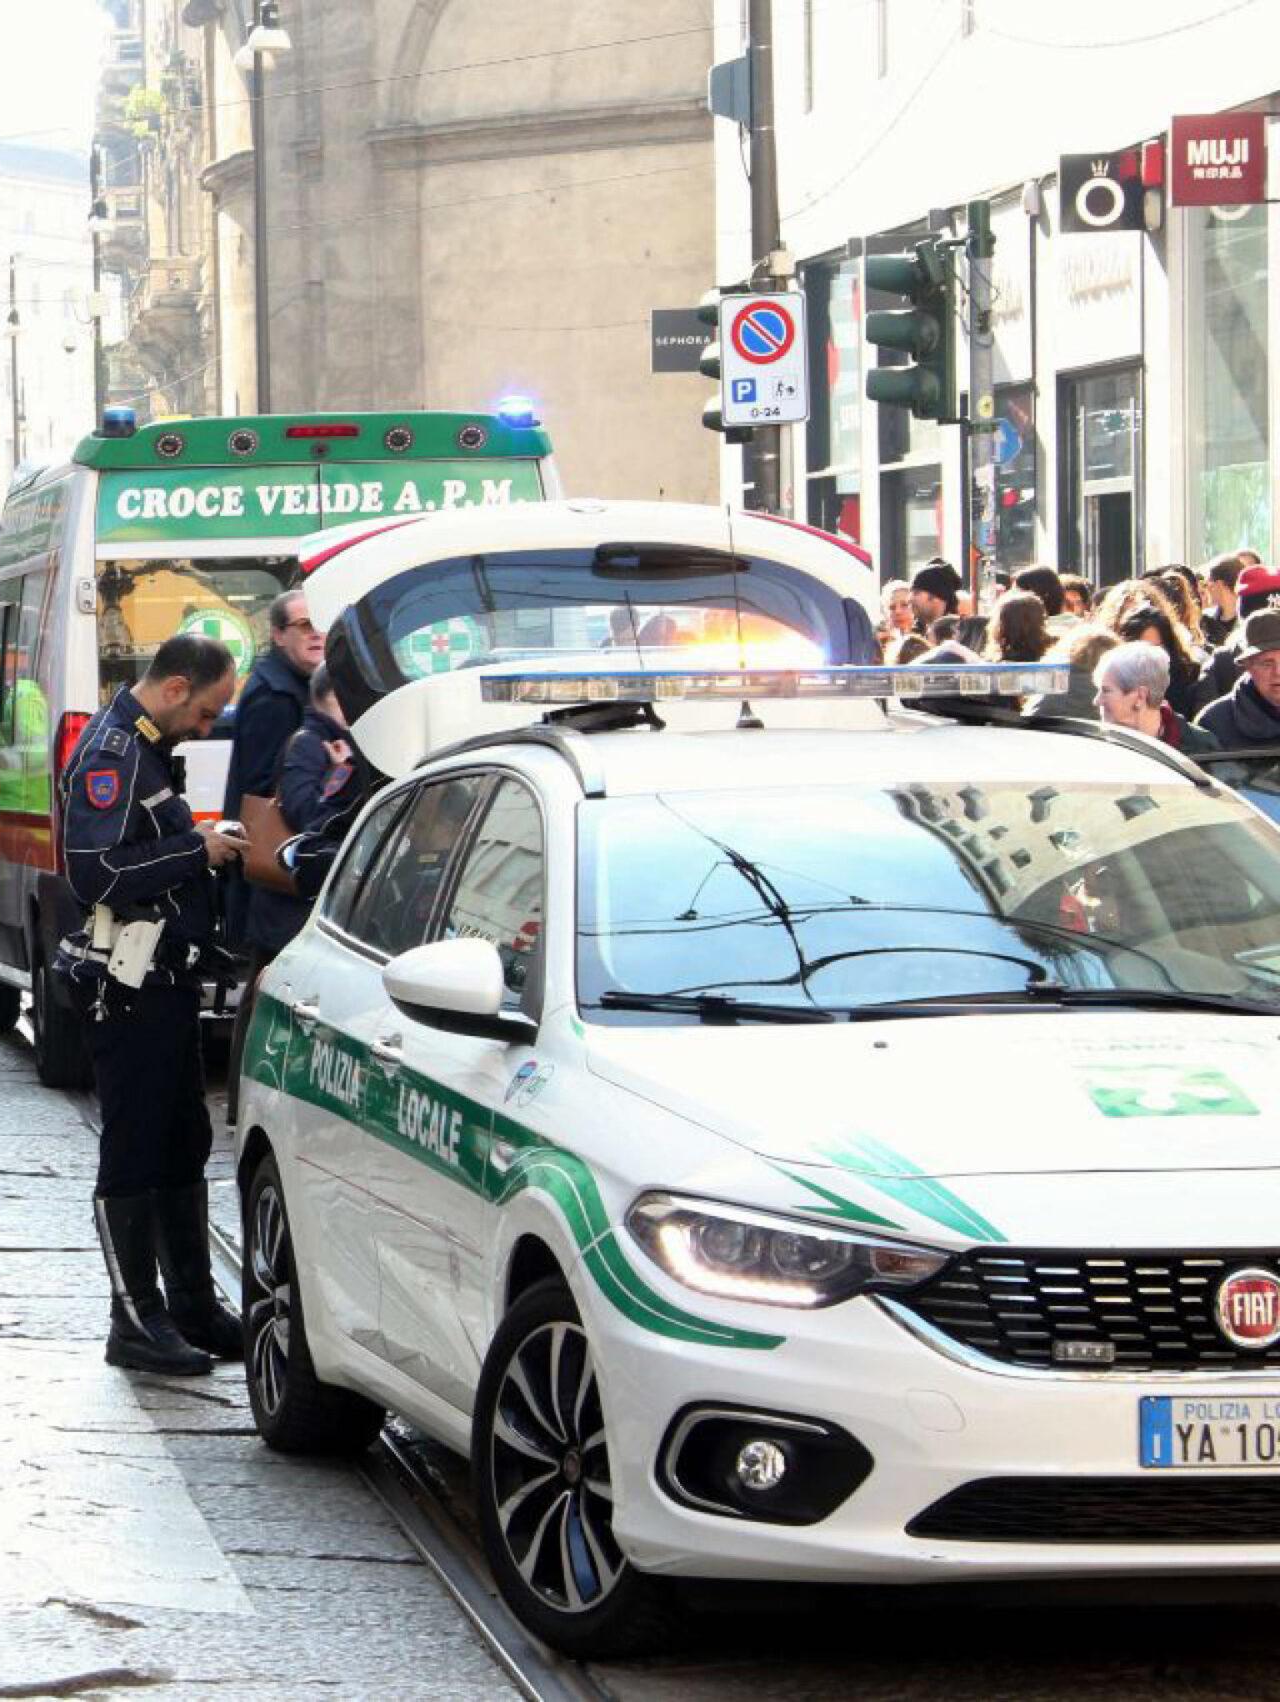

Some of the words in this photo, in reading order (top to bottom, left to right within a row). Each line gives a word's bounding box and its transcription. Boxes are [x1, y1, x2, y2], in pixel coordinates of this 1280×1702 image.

[1187, 138, 1249, 165] MUJI
[655, 335, 711, 347] SEPHORA
[751, 407, 781, 417] 0-24
[116, 485, 245, 519] CROCE
[256, 481, 384, 516] VERDE
[309, 1038, 362, 1109] POLIZIA
[397, 1082, 463, 1168] LOCALE
[1233, 1291, 1276, 1327] FIAT
[1184, 1403, 1251, 1420] POLIZIA
[1176, 1422, 1216, 1463] YA
[1237, 1422, 1280, 1463] 10
